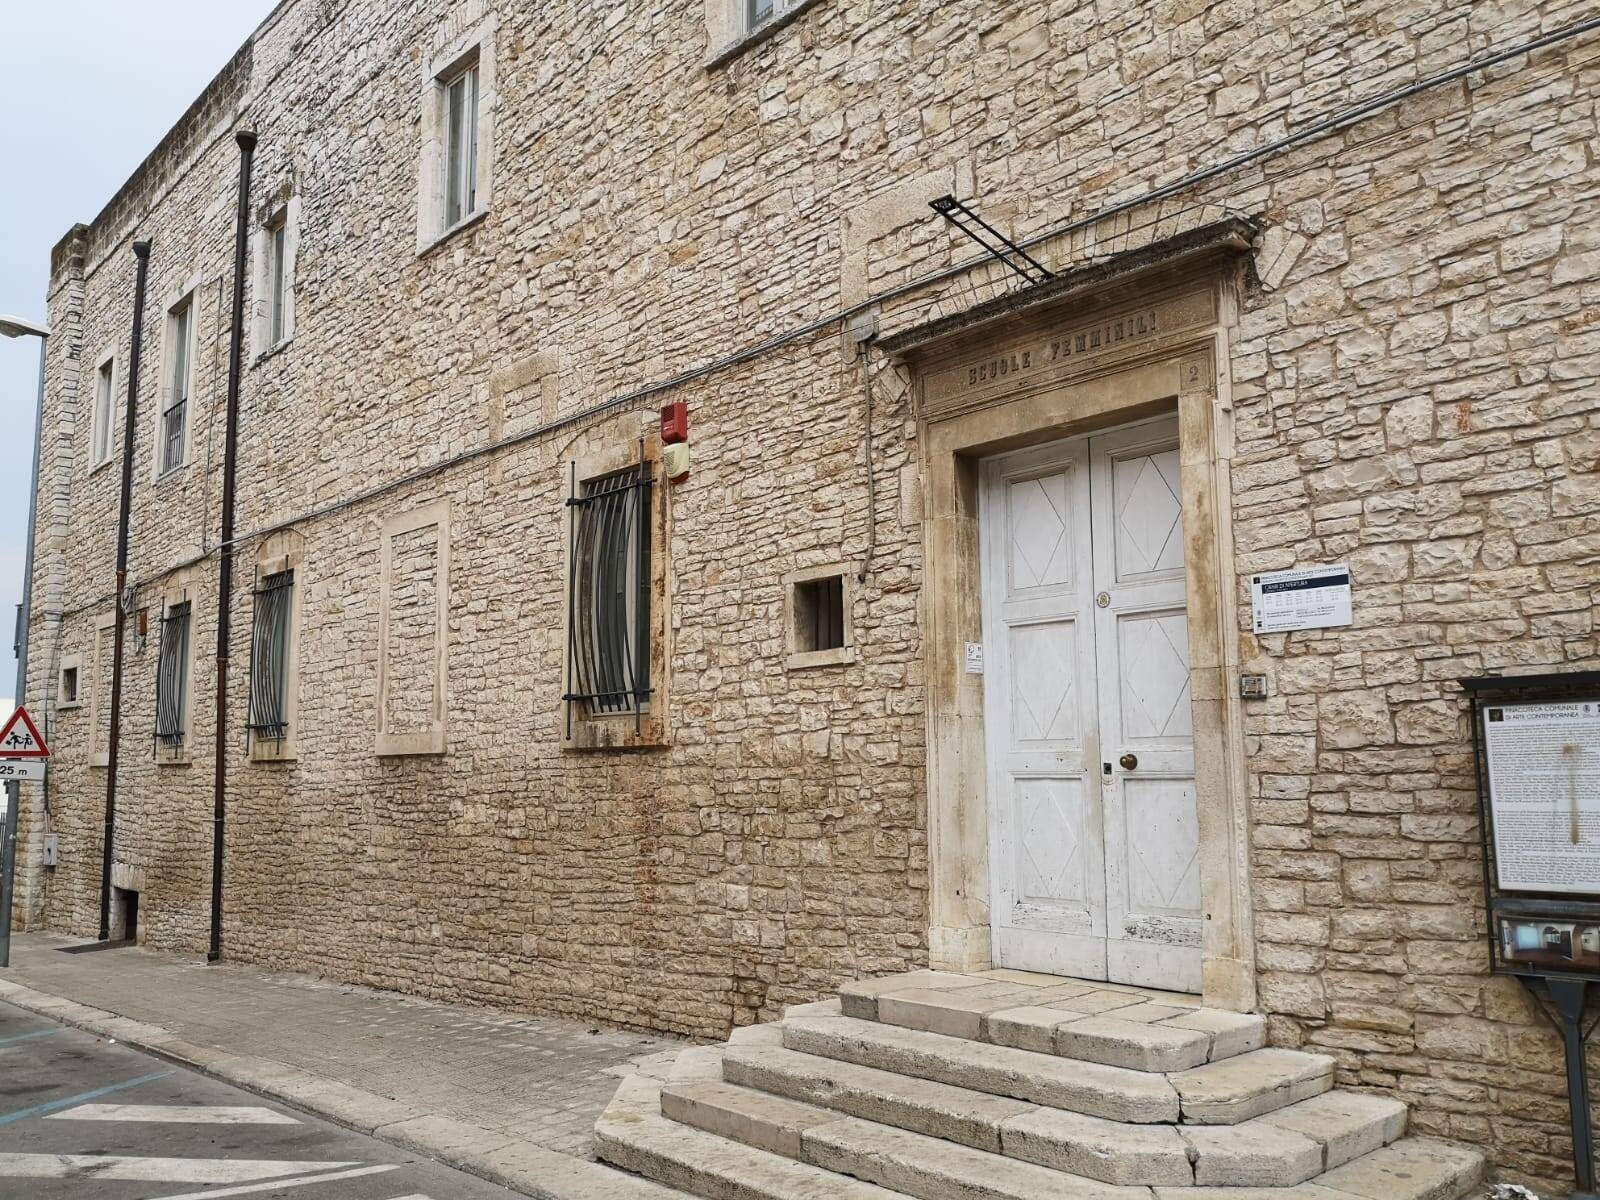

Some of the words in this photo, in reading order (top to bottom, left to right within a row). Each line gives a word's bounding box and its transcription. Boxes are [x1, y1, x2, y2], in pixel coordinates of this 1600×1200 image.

[968, 350, 1032, 386] SCUOLE
[1051, 311, 1157, 361] FEMMINILI
[1188, 365, 1199, 383] 2
[1544, 704, 1579, 712] COMUNALE
[1526, 712, 1579, 720] CONTEMPORANEA
